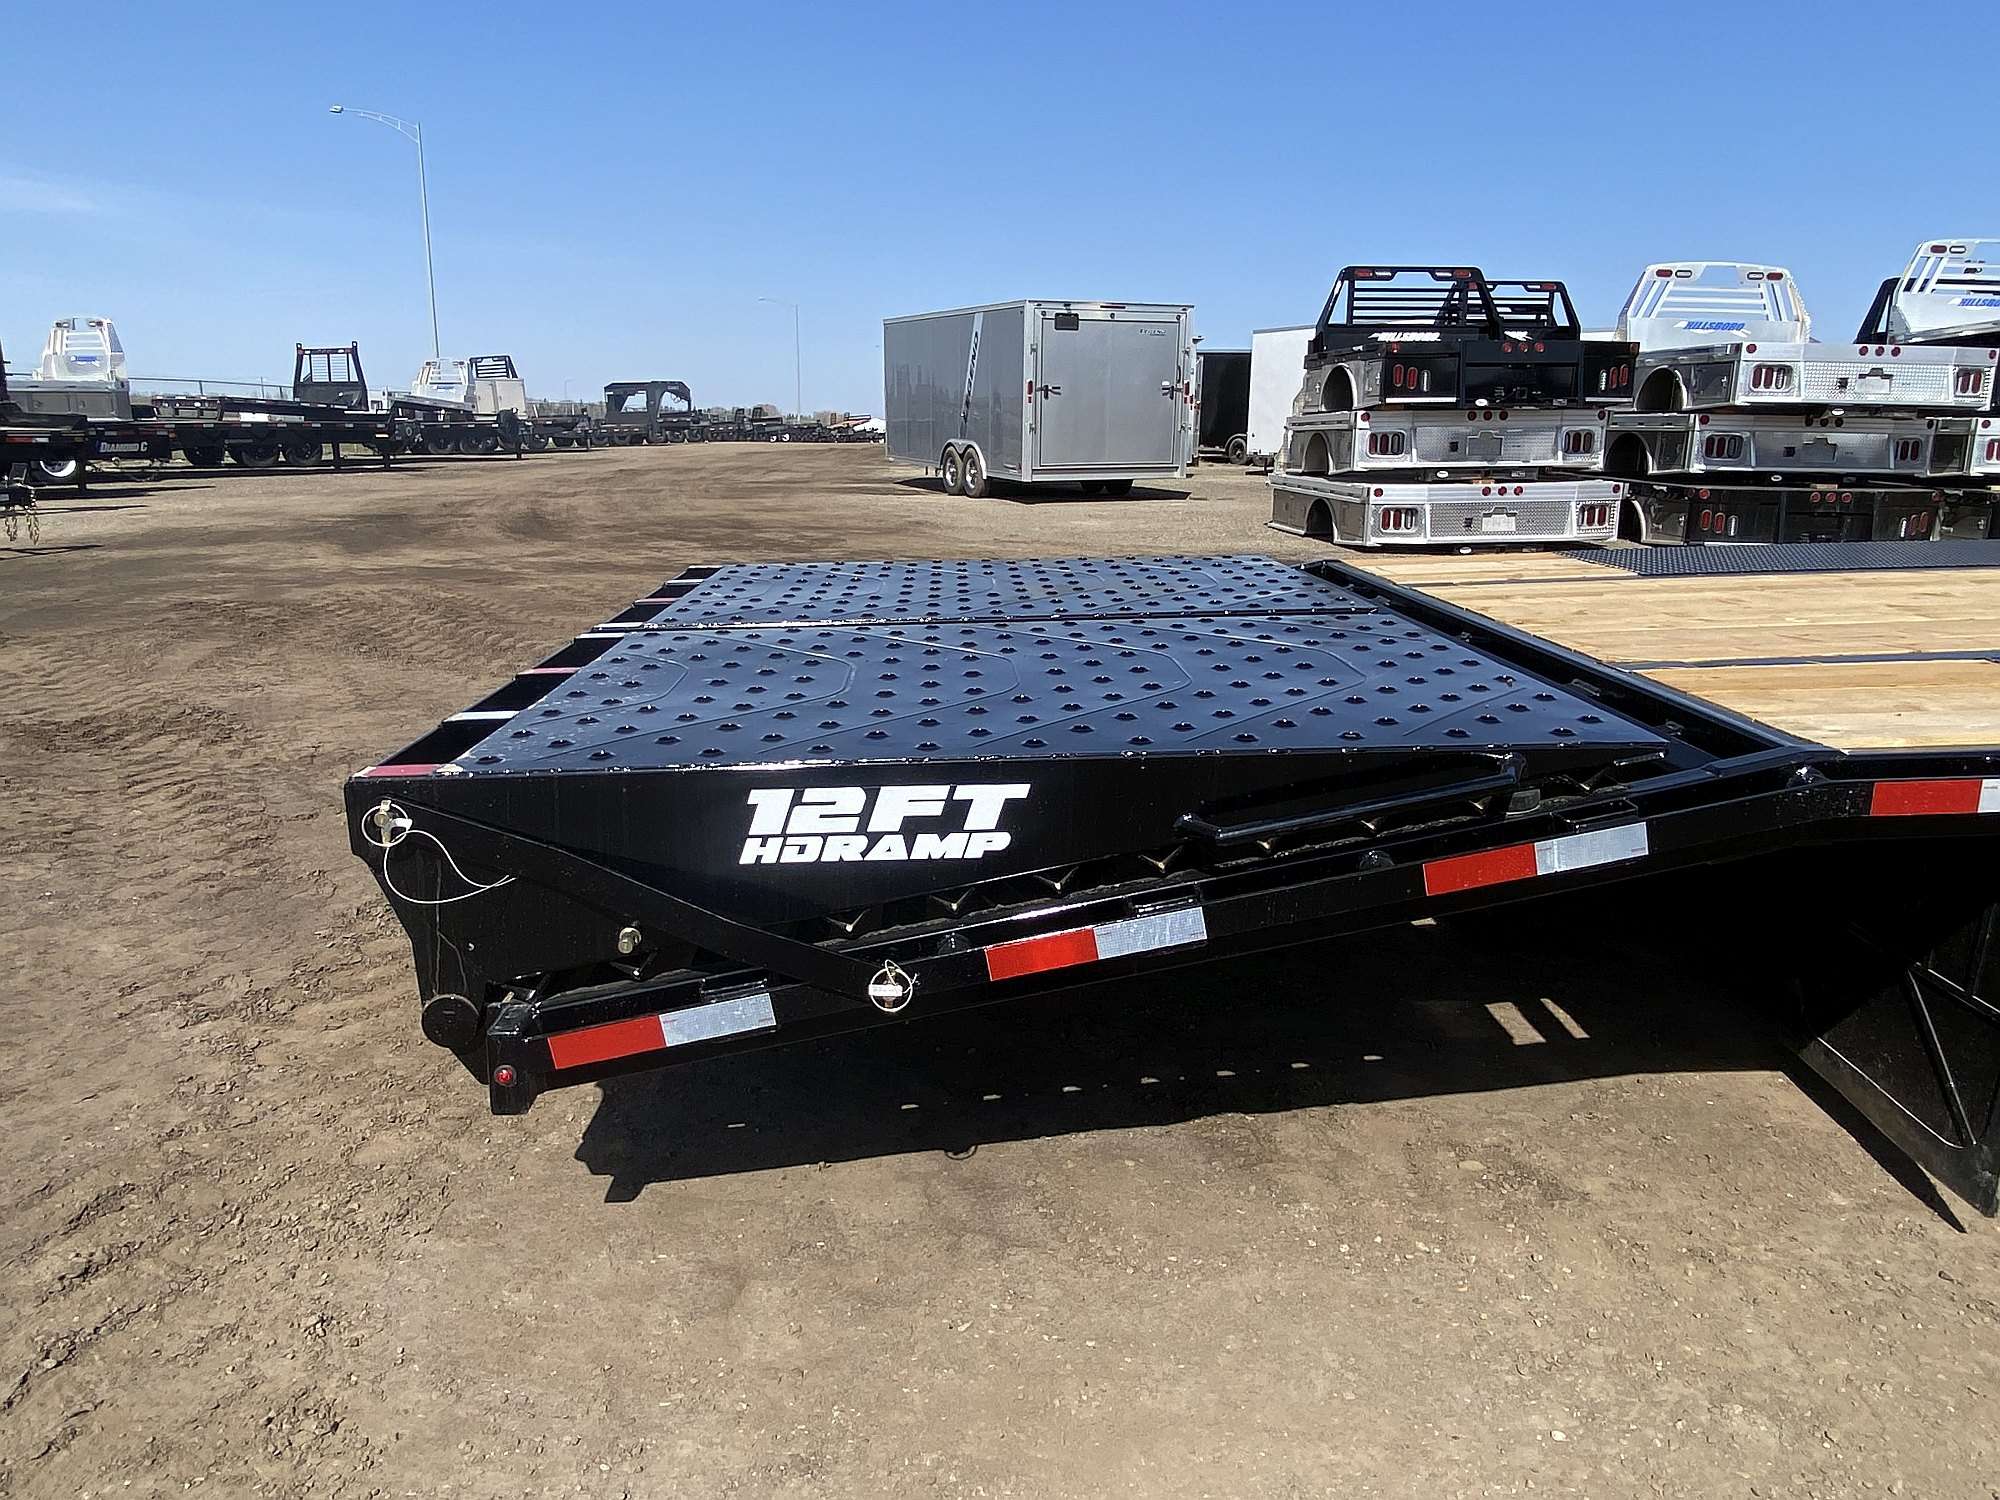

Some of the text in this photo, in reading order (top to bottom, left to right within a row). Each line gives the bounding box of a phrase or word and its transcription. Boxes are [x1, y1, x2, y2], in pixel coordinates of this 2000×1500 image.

[1683, 321, 1745, 331] HILLSBORO
[141, 442, 148, 451] C
[747, 784, 1031, 836] 12FT
[738, 831, 1012, 865] HDRAMP
